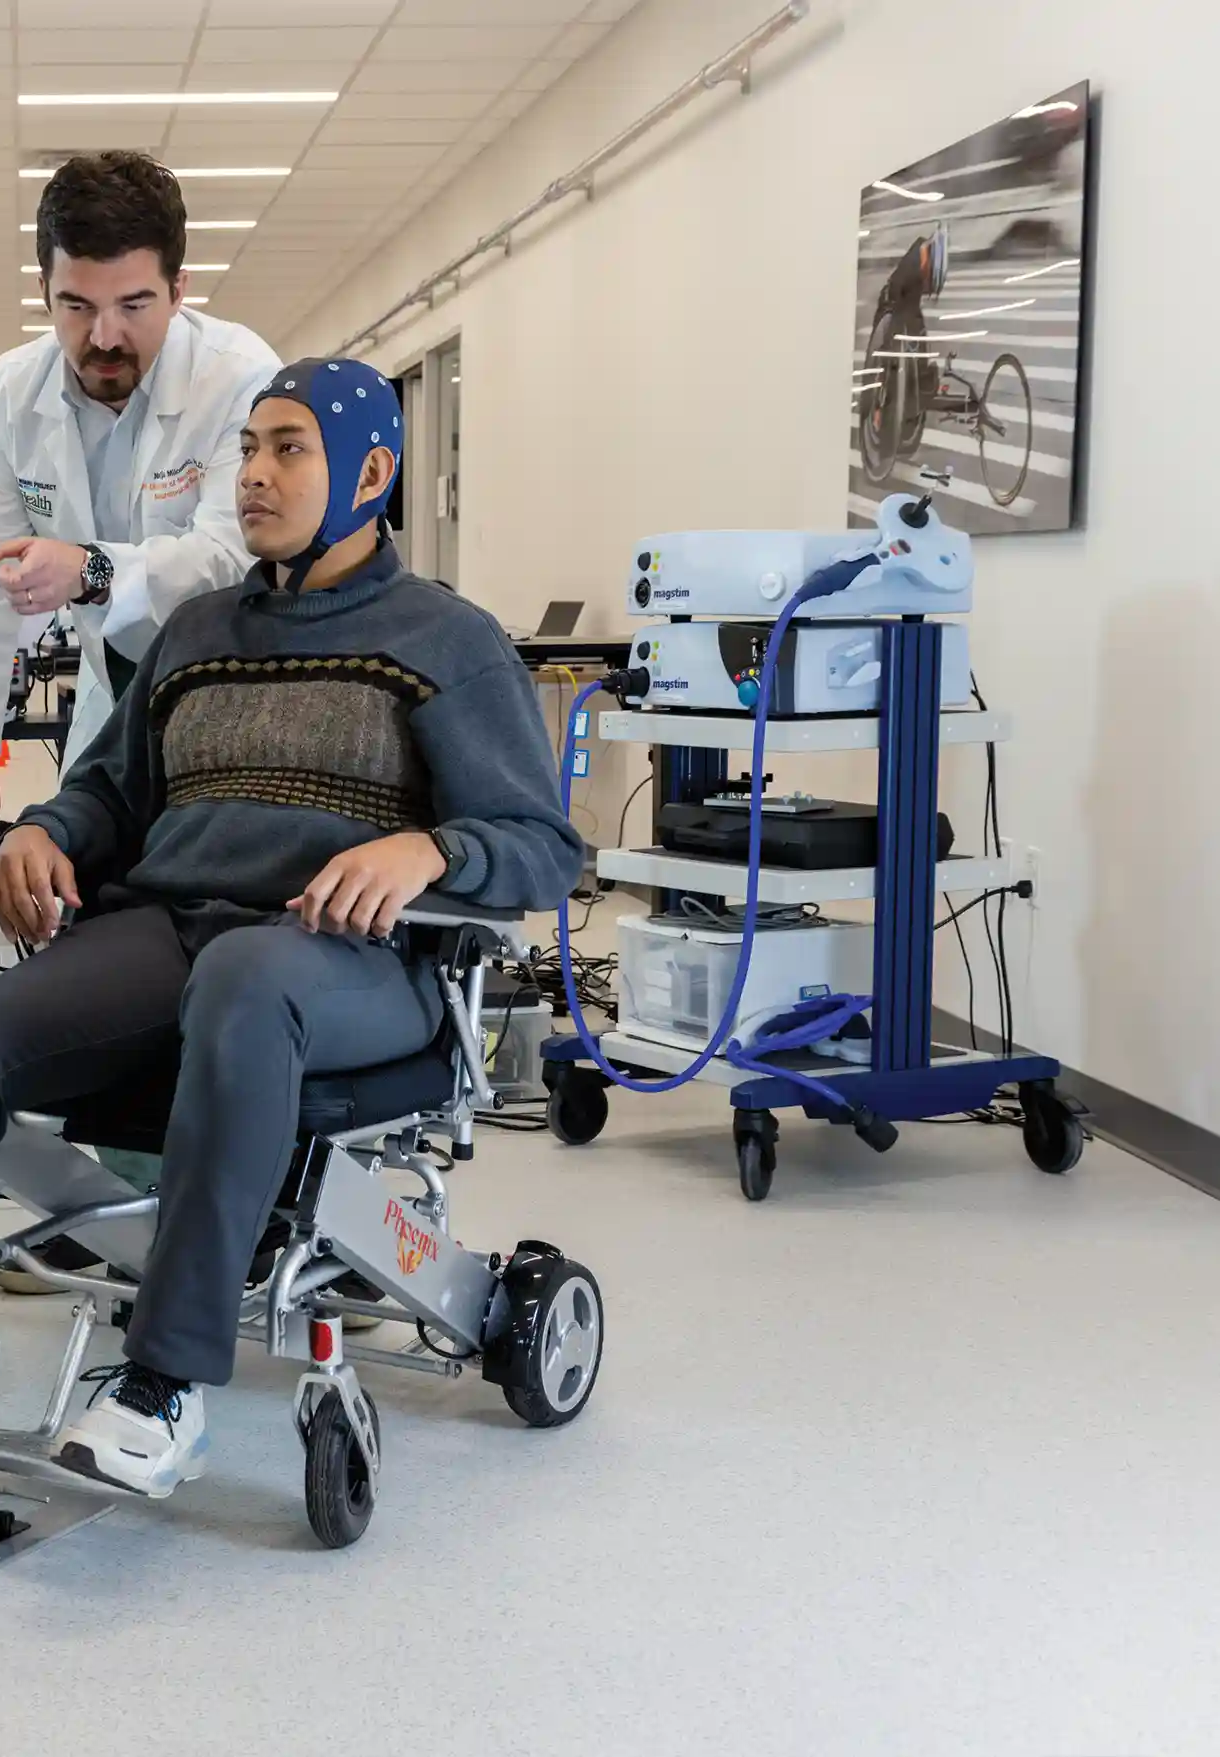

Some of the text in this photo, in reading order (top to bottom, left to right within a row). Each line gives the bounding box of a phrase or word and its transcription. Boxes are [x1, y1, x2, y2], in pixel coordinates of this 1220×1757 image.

[654, 586, 690, 600] magstim
[652, 676, 689, 691] magstim
[383, 1198, 440, 1263] Phoenix
